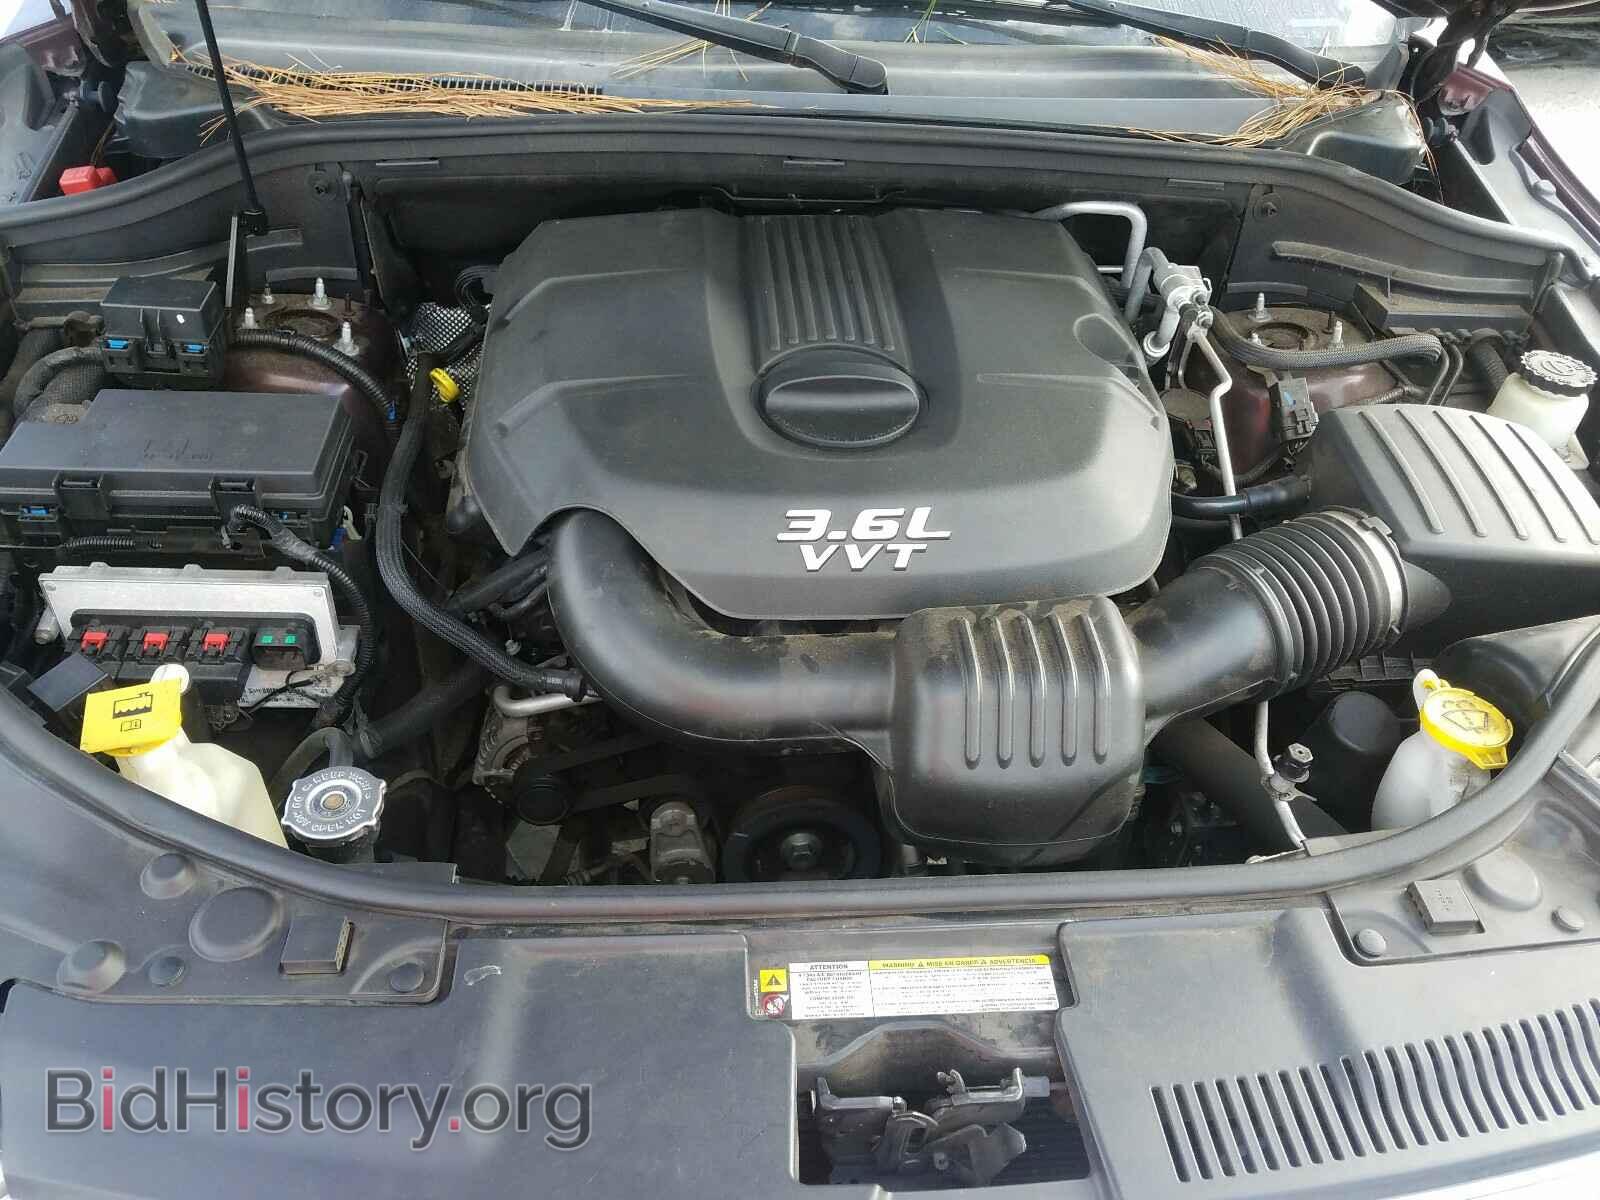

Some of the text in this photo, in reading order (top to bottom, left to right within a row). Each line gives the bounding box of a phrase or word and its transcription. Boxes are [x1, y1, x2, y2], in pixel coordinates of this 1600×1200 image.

[777, 507, 952, 542] 3.6L
[799, 543, 927, 572] VVT
[809, 963, 849, 971] ATTENTION
